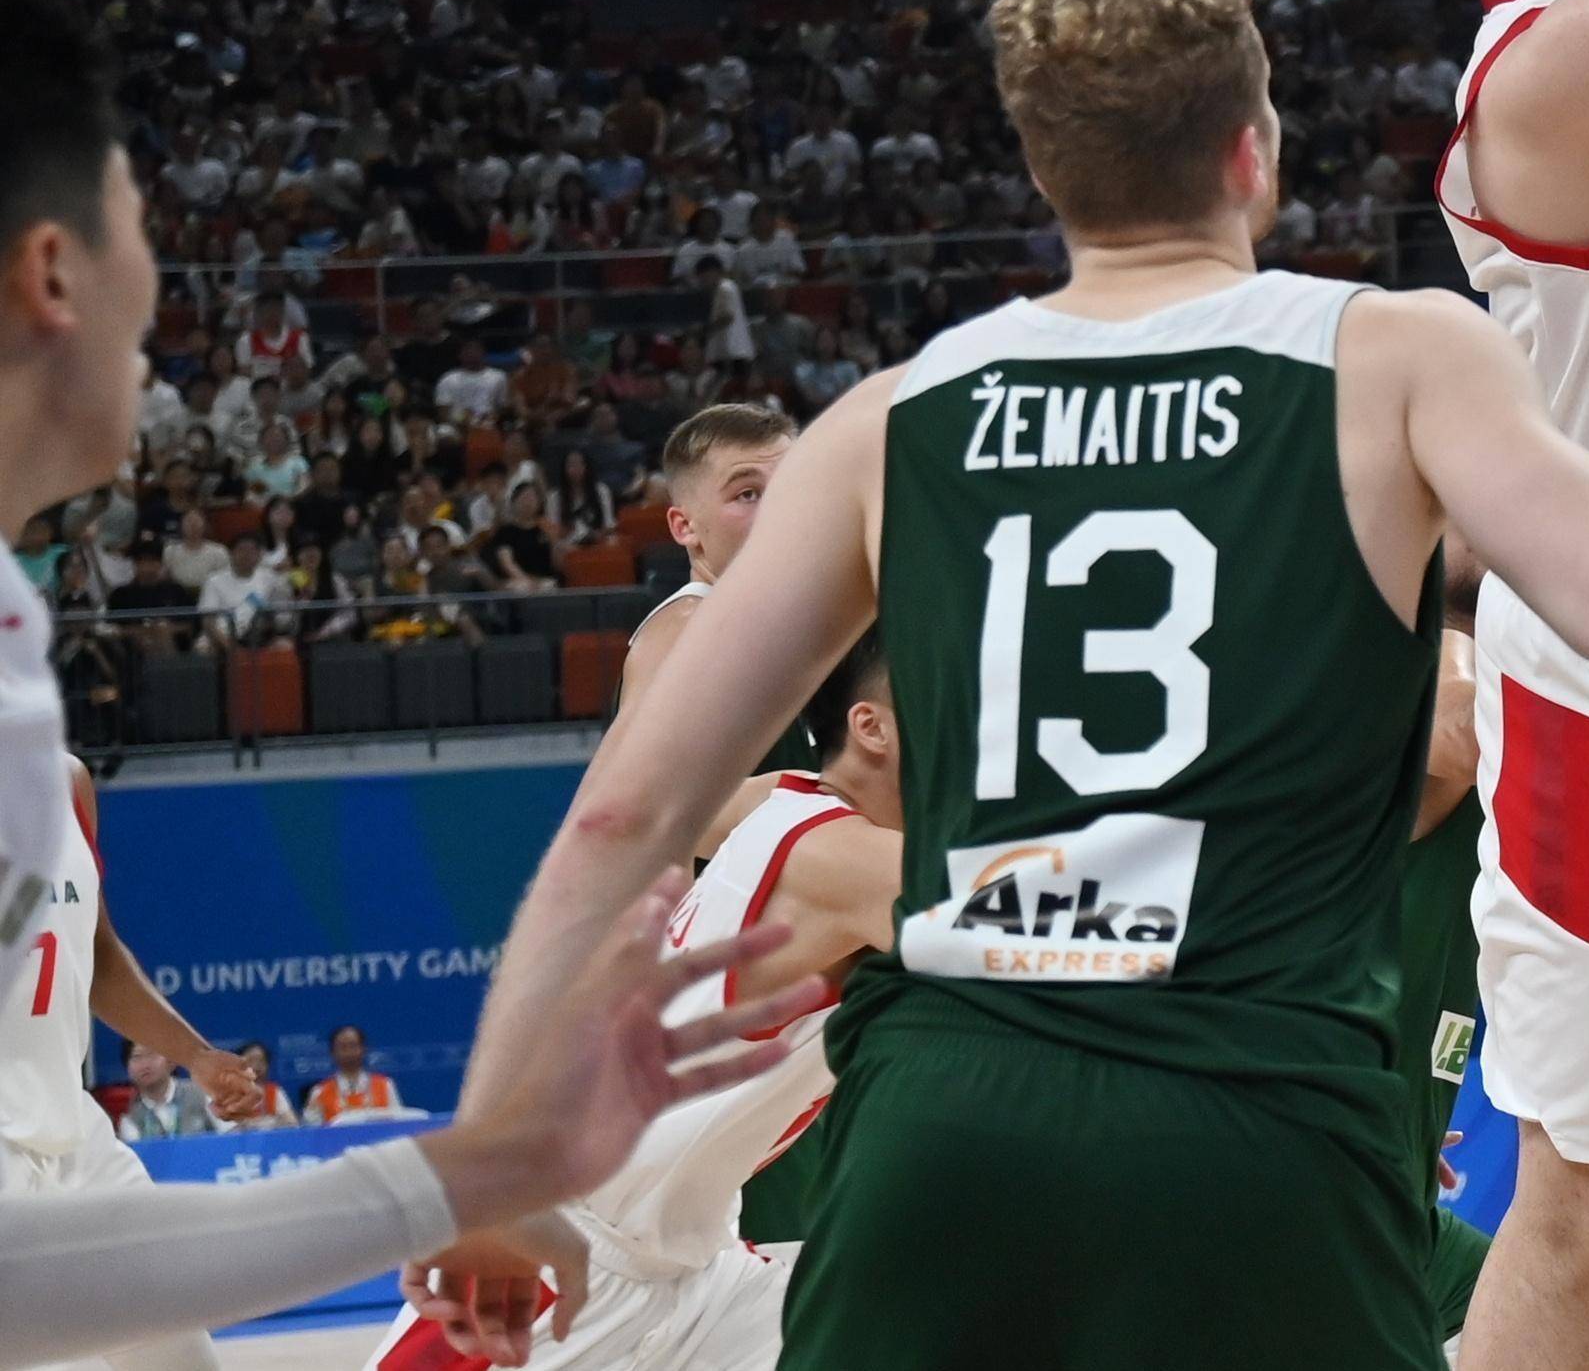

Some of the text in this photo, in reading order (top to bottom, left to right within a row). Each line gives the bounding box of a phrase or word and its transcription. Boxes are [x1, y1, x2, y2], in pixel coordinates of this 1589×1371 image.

[963, 371, 1243, 472] ŽEMAITIS
[975, 508, 1219, 802] 13
[951, 872, 1180, 944] Arka
[191, 950, 409, 994] UNIVERSITY
[418, 947, 505, 979] GAM
[983, 948, 1170, 976] EXPRESS
